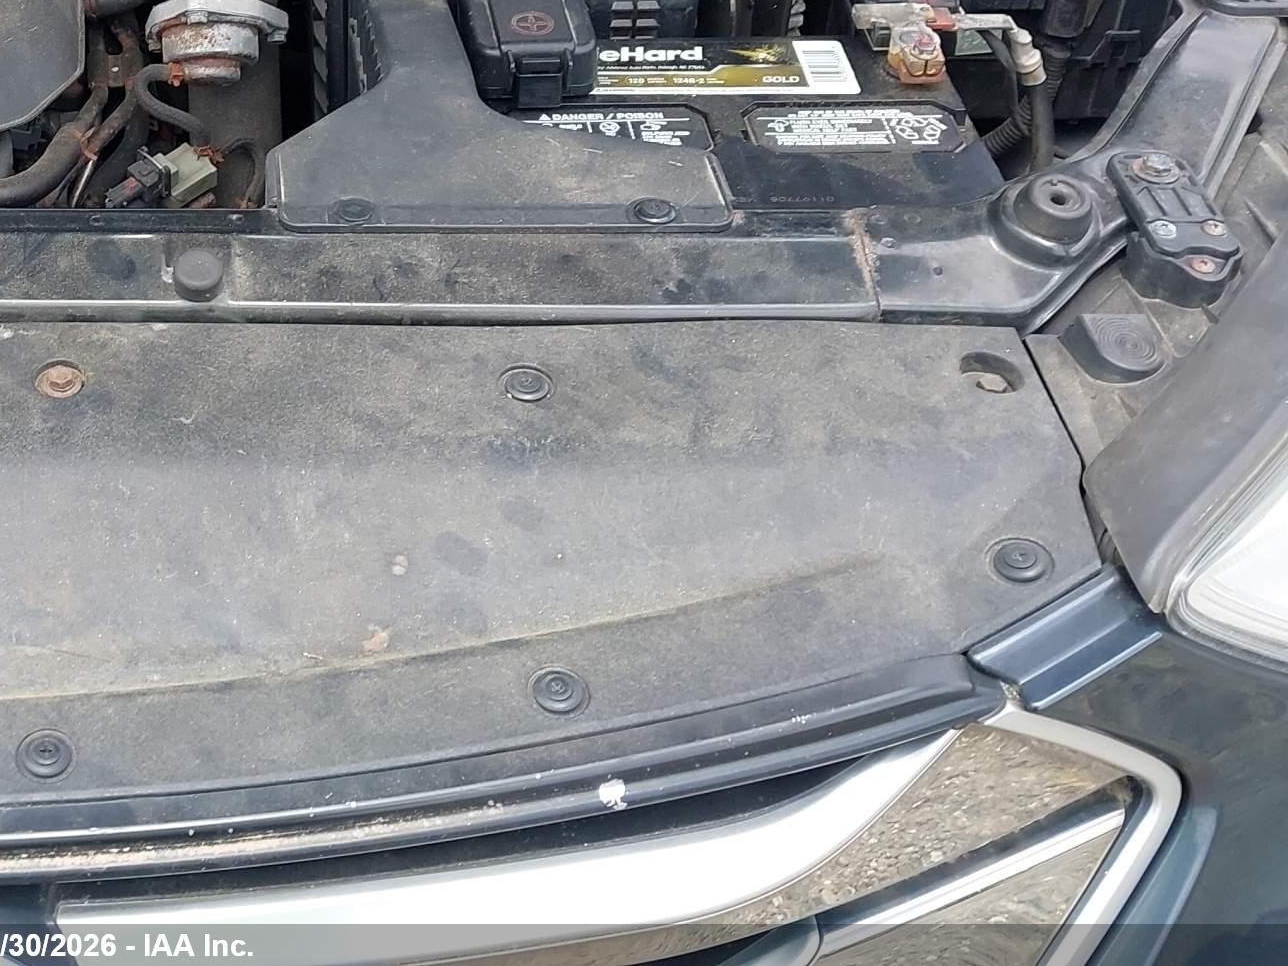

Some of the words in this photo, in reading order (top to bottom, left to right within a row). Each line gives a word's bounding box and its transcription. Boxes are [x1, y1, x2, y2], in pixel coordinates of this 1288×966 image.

[596, 46, 703, 62] eHard
[762, 75, 801, 84] GOLD
[552, 113, 604, 121] DANGER
[616, 112, 665, 120] POISON
